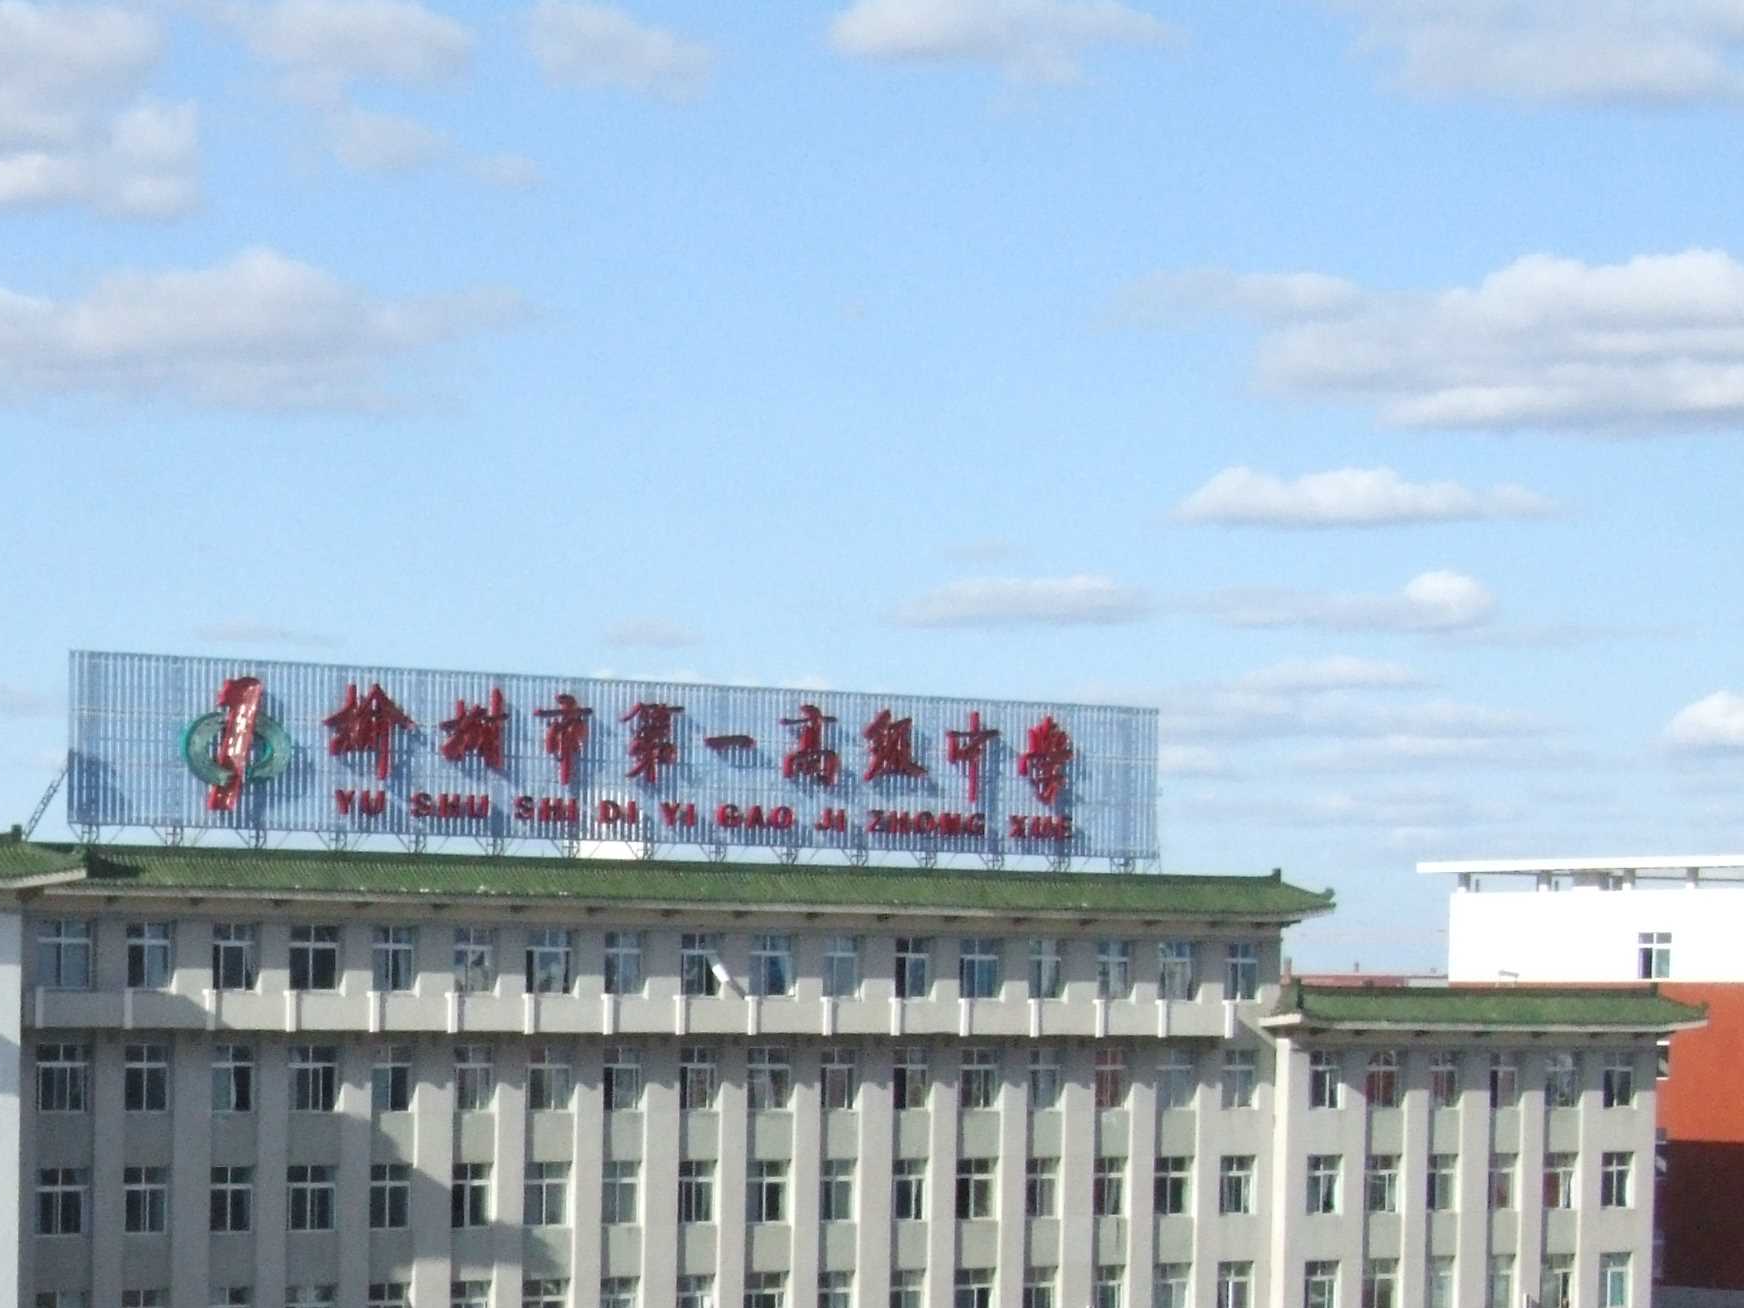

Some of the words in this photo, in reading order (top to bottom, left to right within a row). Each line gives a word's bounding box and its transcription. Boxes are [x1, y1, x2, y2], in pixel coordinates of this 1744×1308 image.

[335, 789, 386, 817] YU
[409, 791, 489, 819] SHU
[514, 795, 577, 823] SHI
[598, 799, 637, 825] DI
[662, 801, 696, 827] YI
[715, 803, 795, 830] GAO
[816, 807, 845, 832] JI
[867, 808, 985, 837] ZHONG
[1009, 814, 1073, 839] XUE
